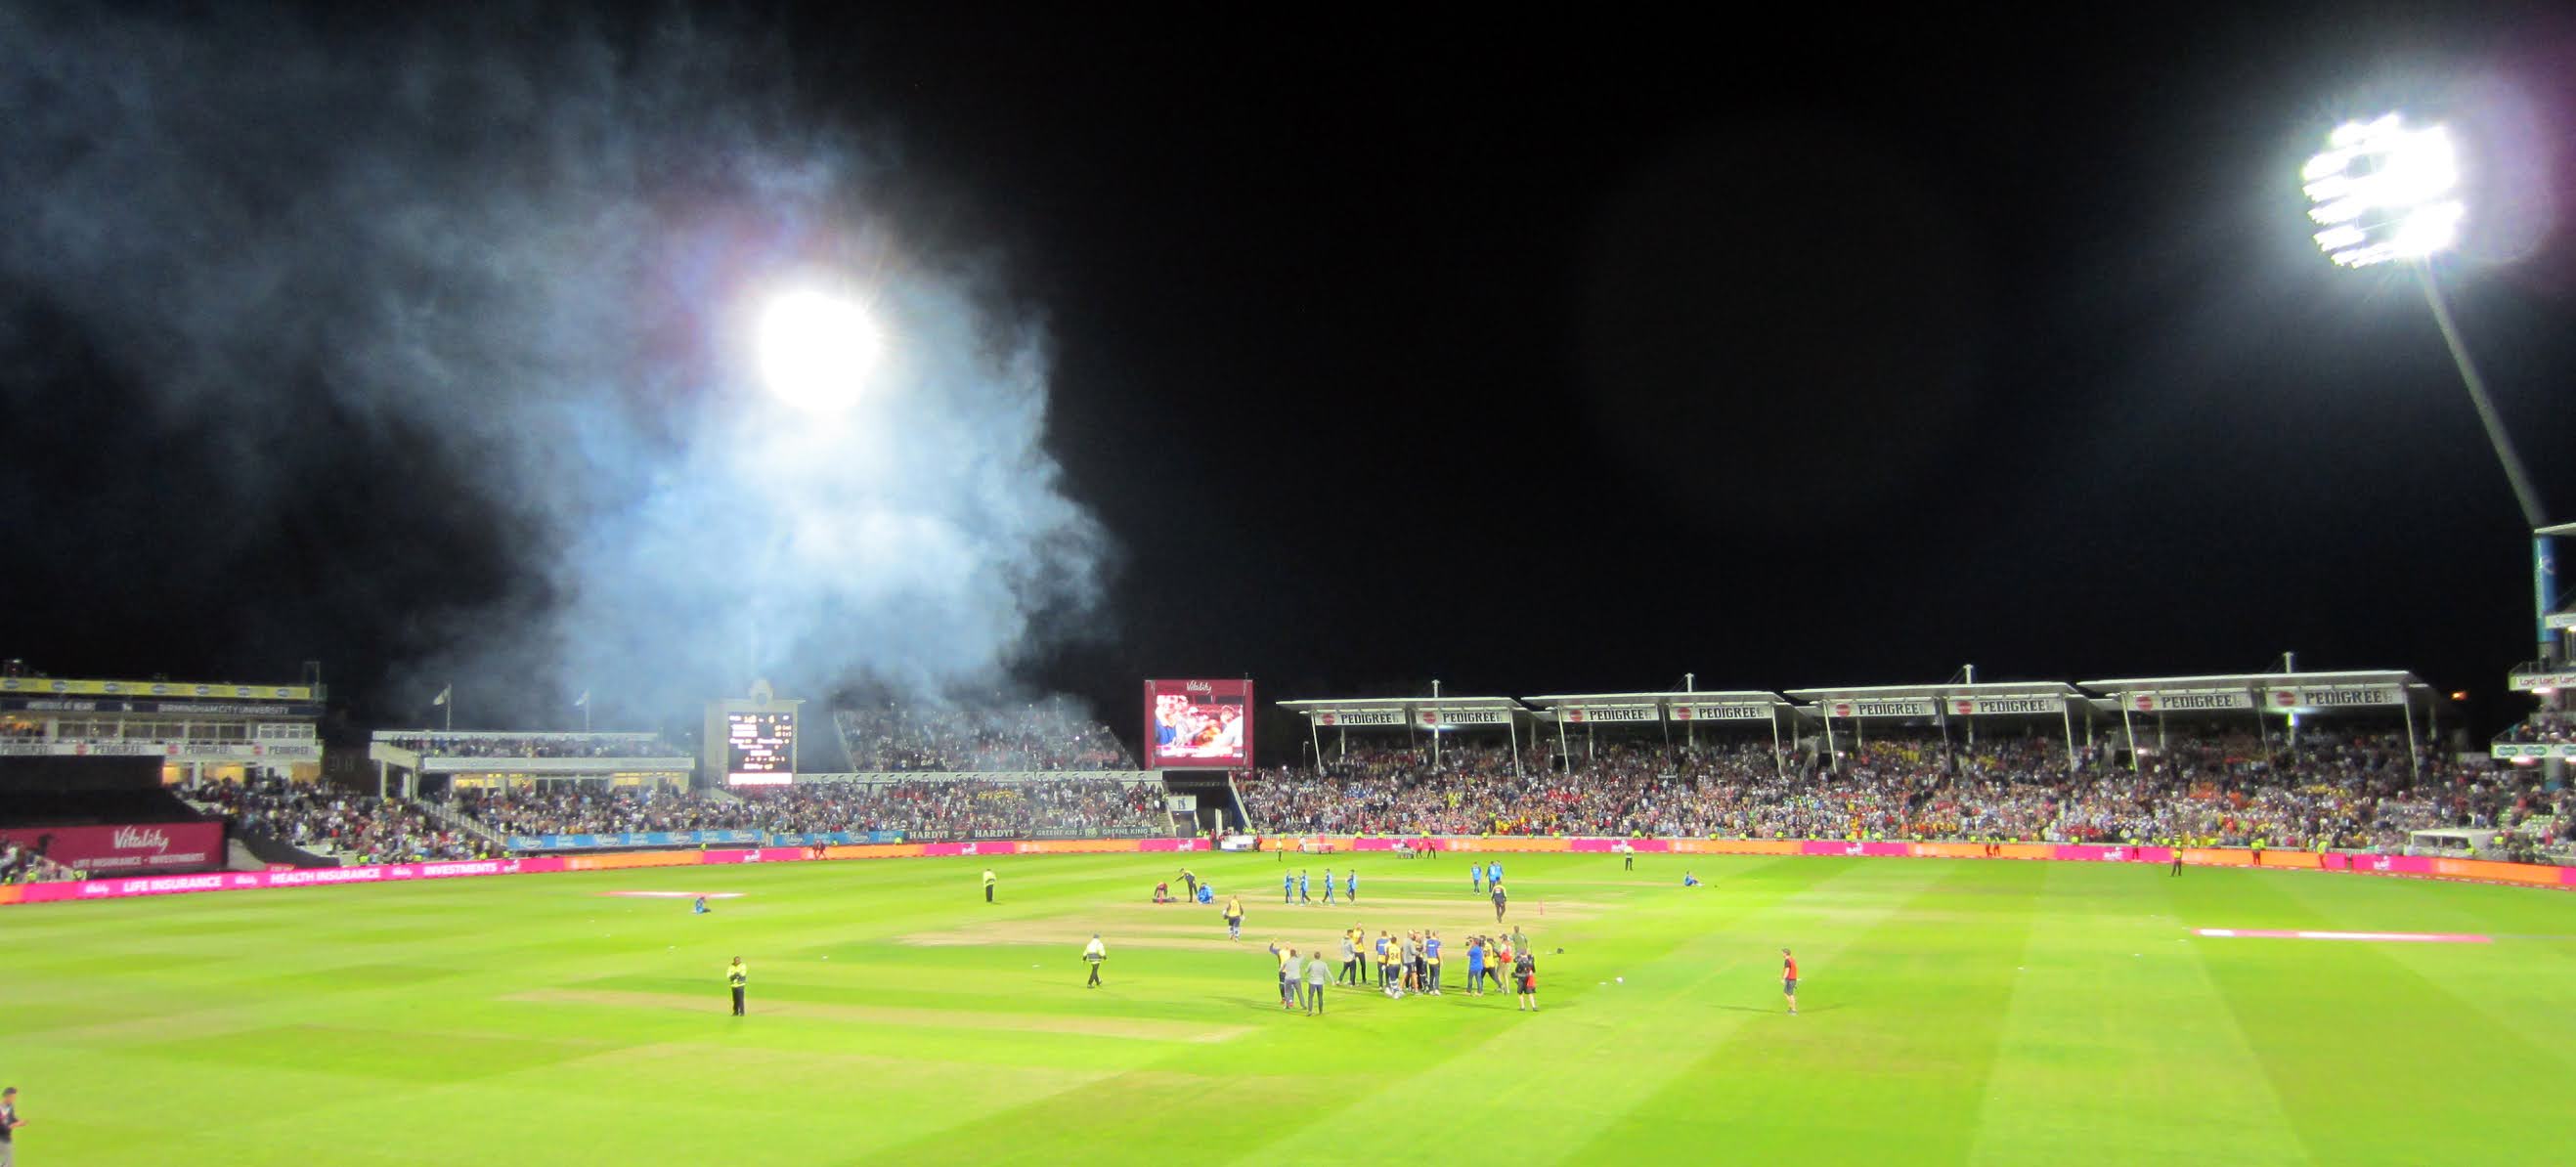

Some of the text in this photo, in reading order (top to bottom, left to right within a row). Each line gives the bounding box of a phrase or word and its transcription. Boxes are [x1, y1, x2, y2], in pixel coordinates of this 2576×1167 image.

[1187, 680, 1211, 694] Vitality
[2161, 695, 2232, 709] PEDIGREE
[2305, 690, 2381, 705] PEDIGREE
[1698, 707, 1756, 718] PEDIGREE
[1858, 703, 1918, 715] PEDIGREE
[1980, 700, 2046, 713] PEDIGREE
[1341, 713, 1393, 724] PEDIGREE
[1442, 712, 1496, 723] PEDIGREE
[1590, 709, 1643, 720] PEDIGREE
[113, 825, 169, 853] Vitality
[123, 881, 147, 892] LIFE
[149, 876, 222, 890] INSURANCE
[270, 871, 314, 885] HEALTH
[316, 867, 380, 881] INSURANCE
[423, 862, 498, 876] INVESTMENTS
